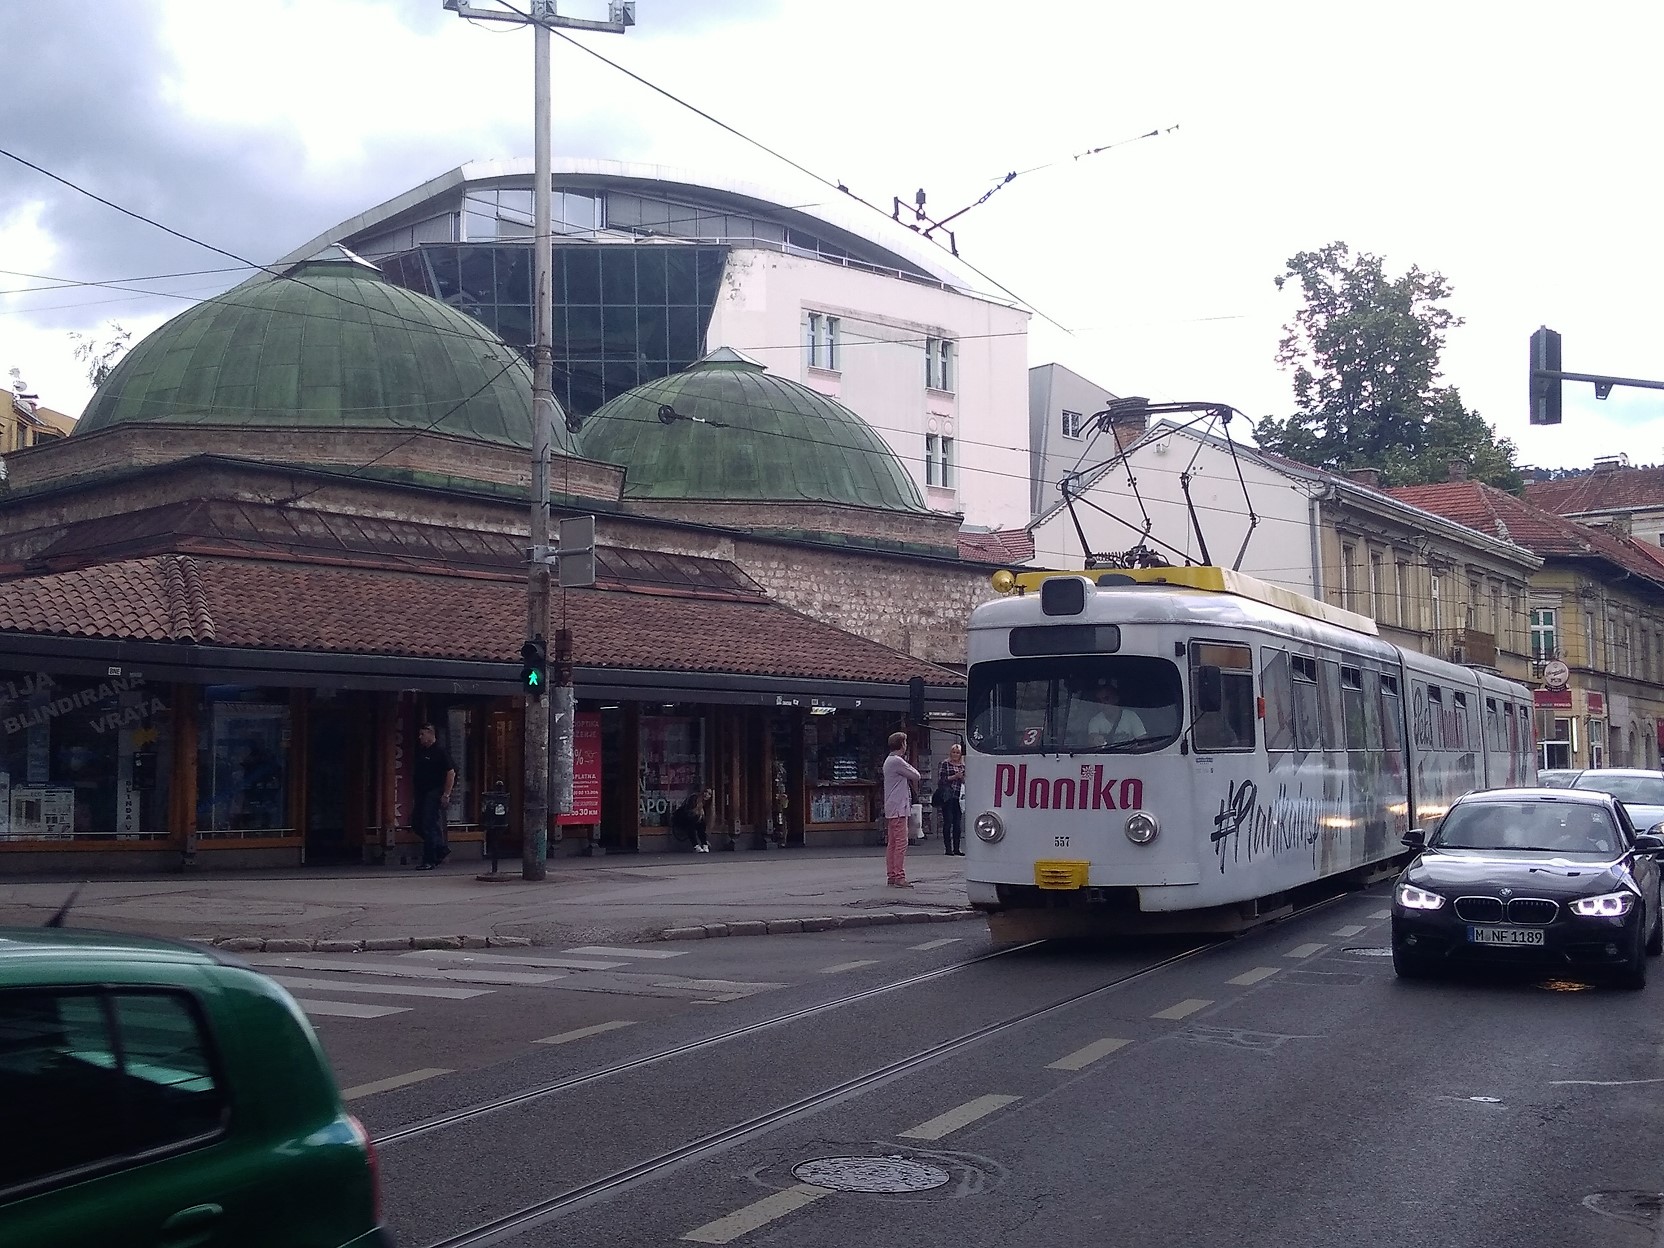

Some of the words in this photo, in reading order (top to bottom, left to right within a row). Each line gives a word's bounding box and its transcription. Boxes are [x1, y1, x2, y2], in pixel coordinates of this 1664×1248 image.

[3, 677, 146, 734] BLINDIRANA
[89, 697, 167, 734] VRATA
[1024, 730, 1038, 746] 3
[993, 763, 1144, 810] Planika
[579, 808, 589, 816] 30
[1055, 836, 1070, 847] 557
[1475, 929, 1484, 941] M
[1492, 930, 1509, 942] NF
[1511, 931, 1543, 944] 1189
